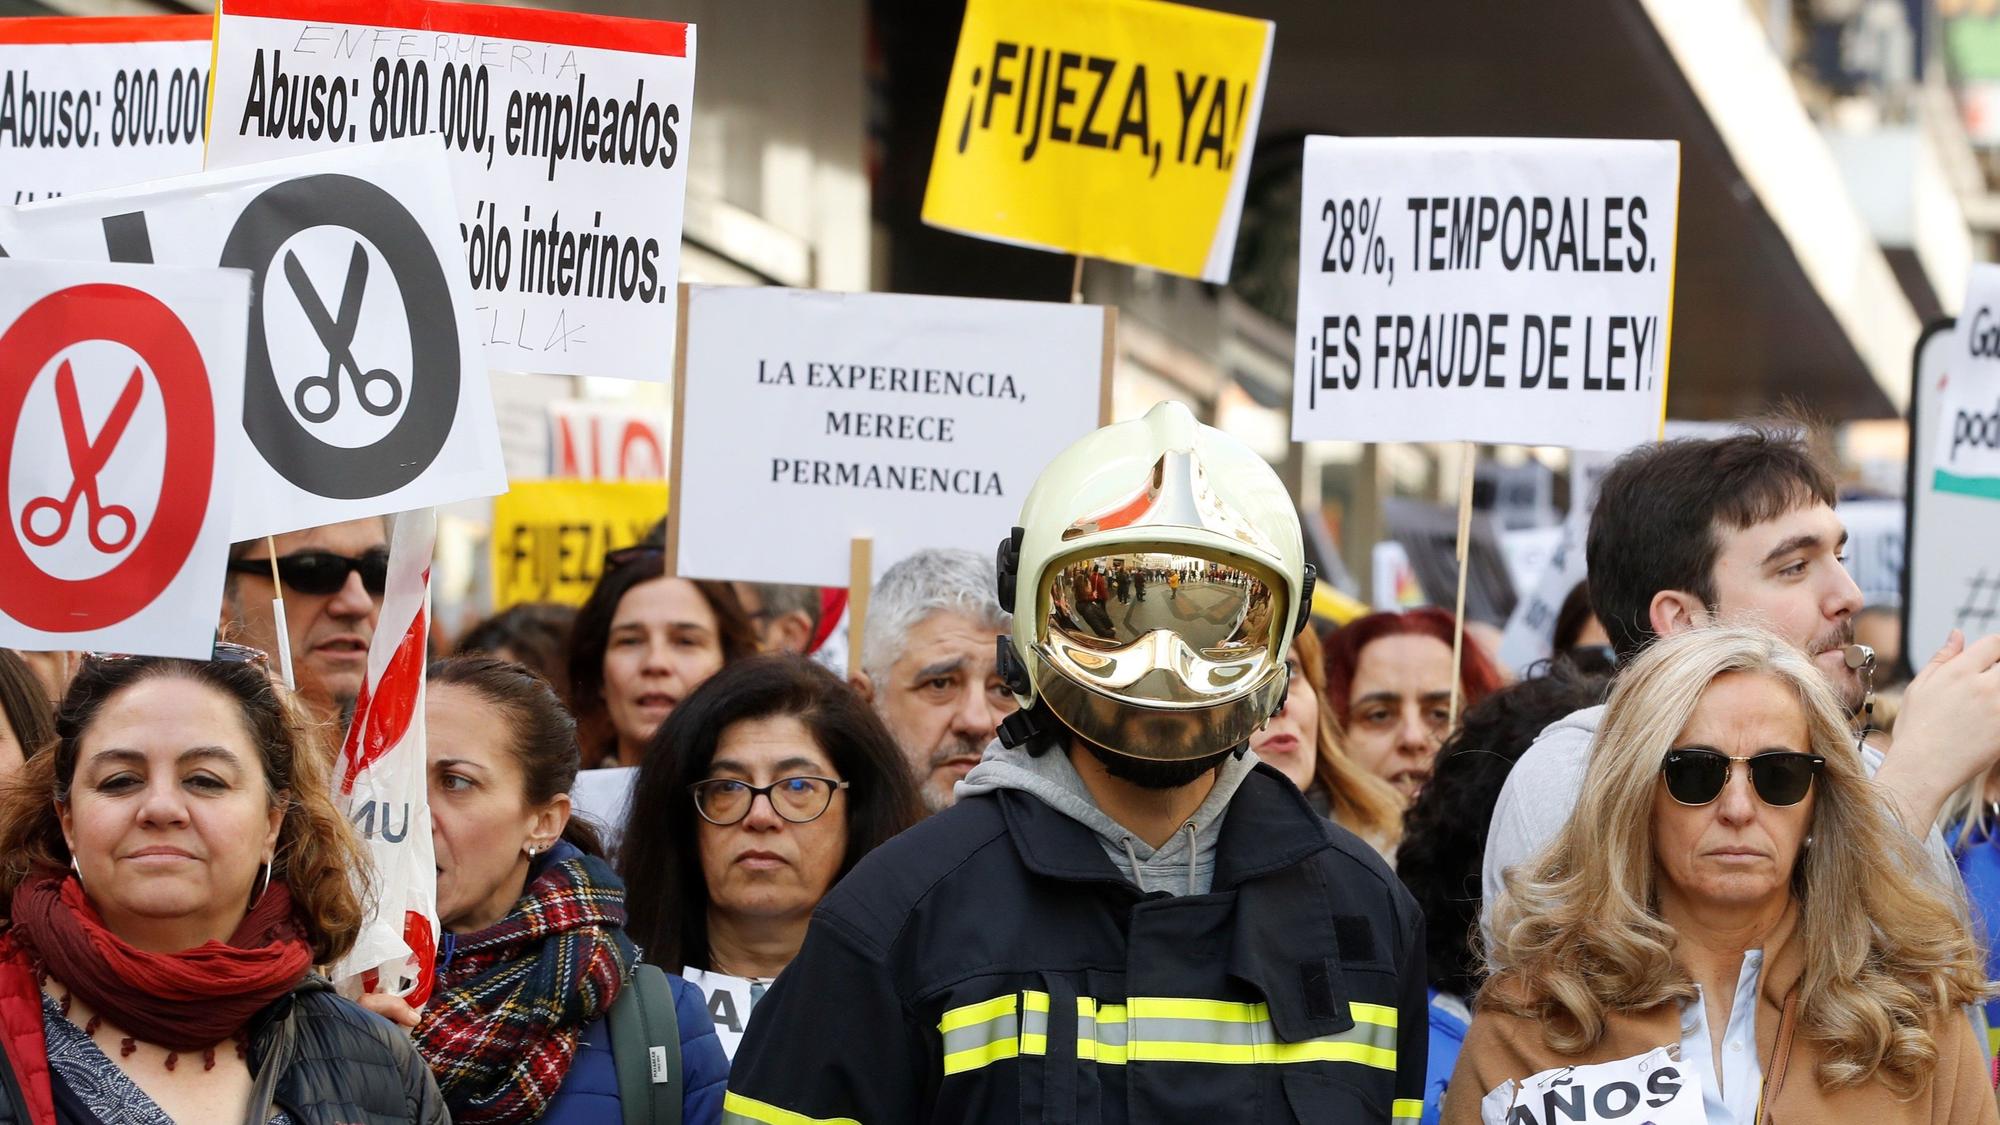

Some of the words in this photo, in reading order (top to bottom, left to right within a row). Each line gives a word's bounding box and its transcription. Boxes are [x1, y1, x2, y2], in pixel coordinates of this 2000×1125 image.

[0, 70, 101, 149] Abuso:
[239, 48, 359, 143] Abuso:
[370, 56, 494, 171] 800000,
[505, 78, 679, 182] empleados
[460, 200, 512, 293] ólo
[520, 205, 667, 304] interinos.
[1321, 197, 1394, 286] 28%,
[1408, 195, 1656, 274] TEMPORALES.
[758, 359, 795, 386] LA
[807, 362, 1026, 403] EXPERIENCIA,
[1309, 314, 1361, 410] ¡ES
[1374, 313, 1509, 389] FRAUDE
[1520, 314, 1571, 390] DE
[1584, 316, 1658, 392] LEY!
[826, 411, 955, 443] MERECE
[771, 458, 1003, 496] PERMANENCIA
